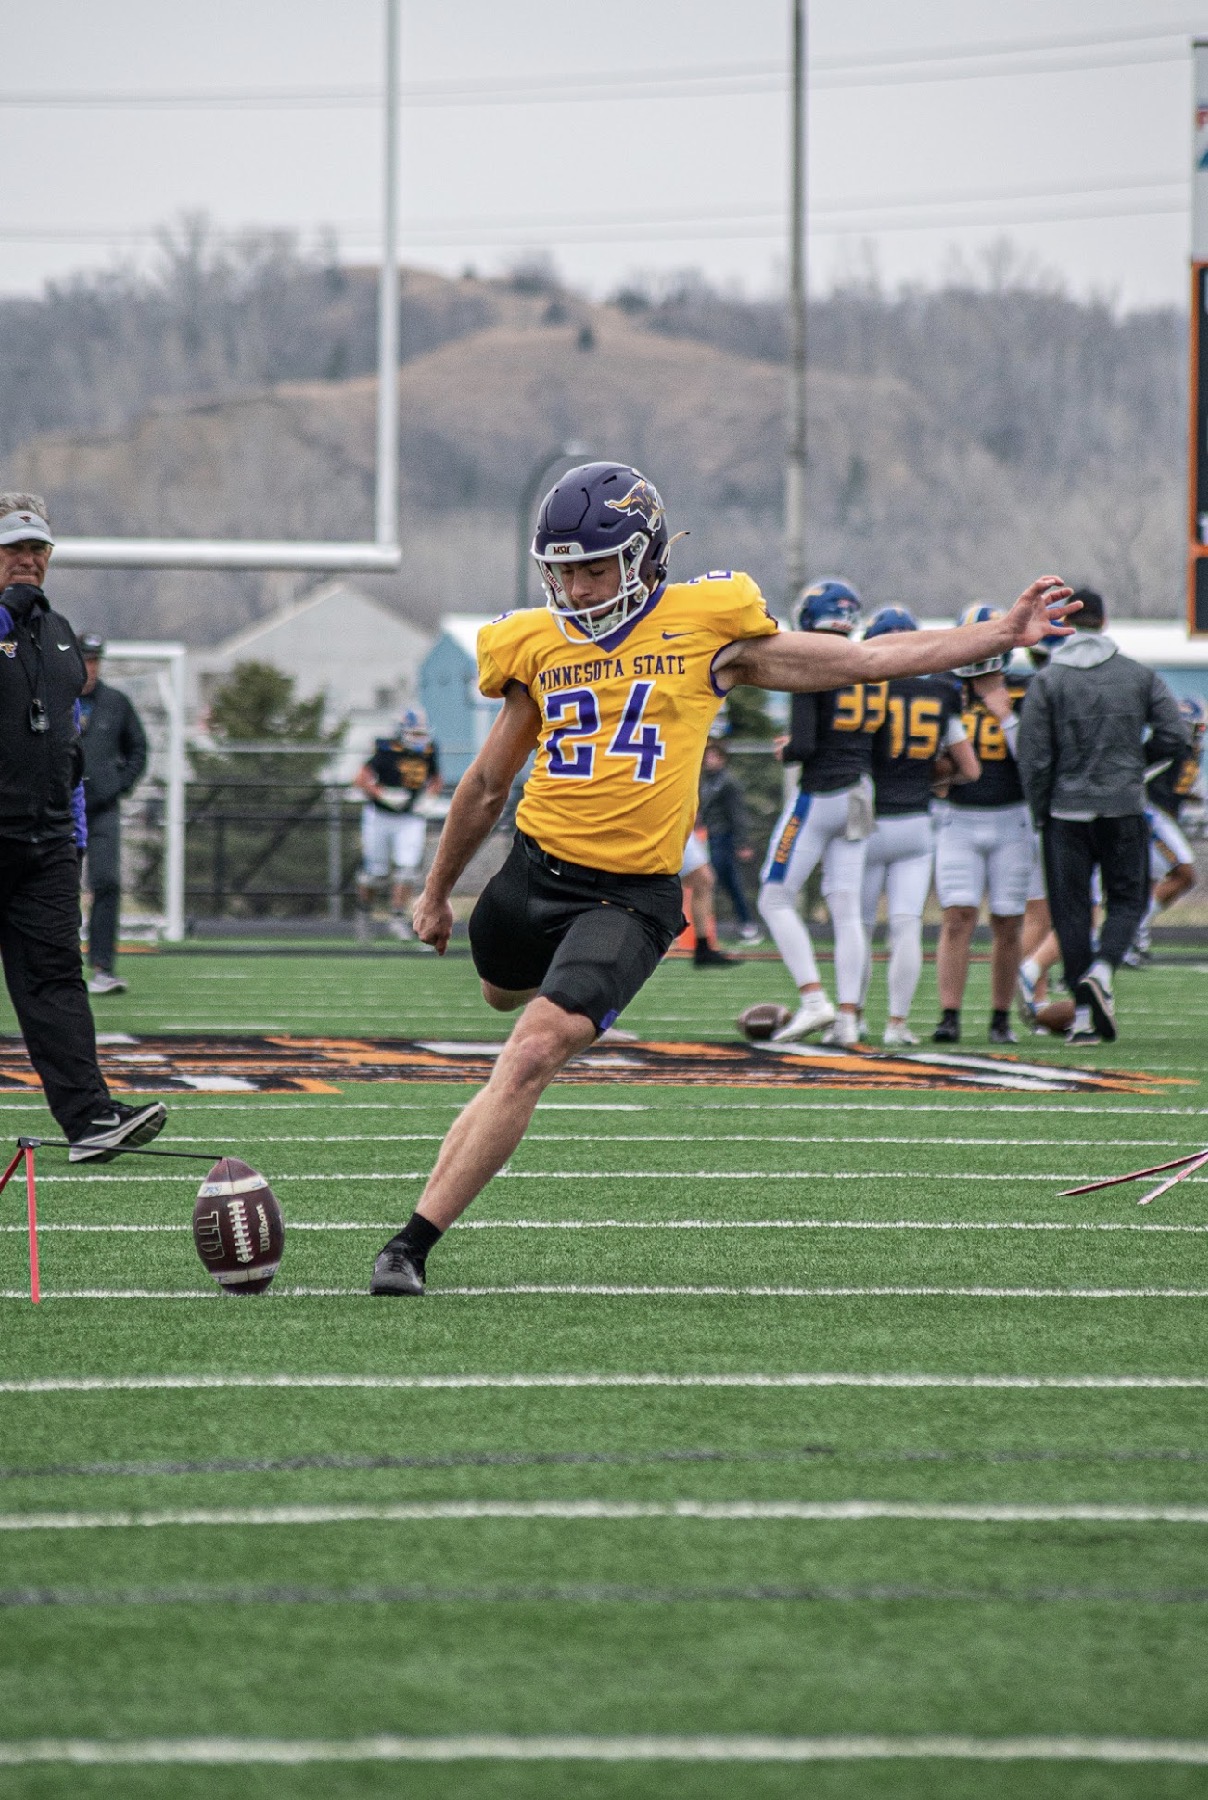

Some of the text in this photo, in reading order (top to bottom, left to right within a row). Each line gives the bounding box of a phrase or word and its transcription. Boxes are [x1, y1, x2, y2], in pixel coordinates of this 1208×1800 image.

[538, 654, 686, 693] MINNESOTA STATE
[543, 679, 667, 784] 24
[832, 681, 889, 733] 33
[887, 697, 942, 759] 15
[255, 1203, 271, 1253] Wilson
